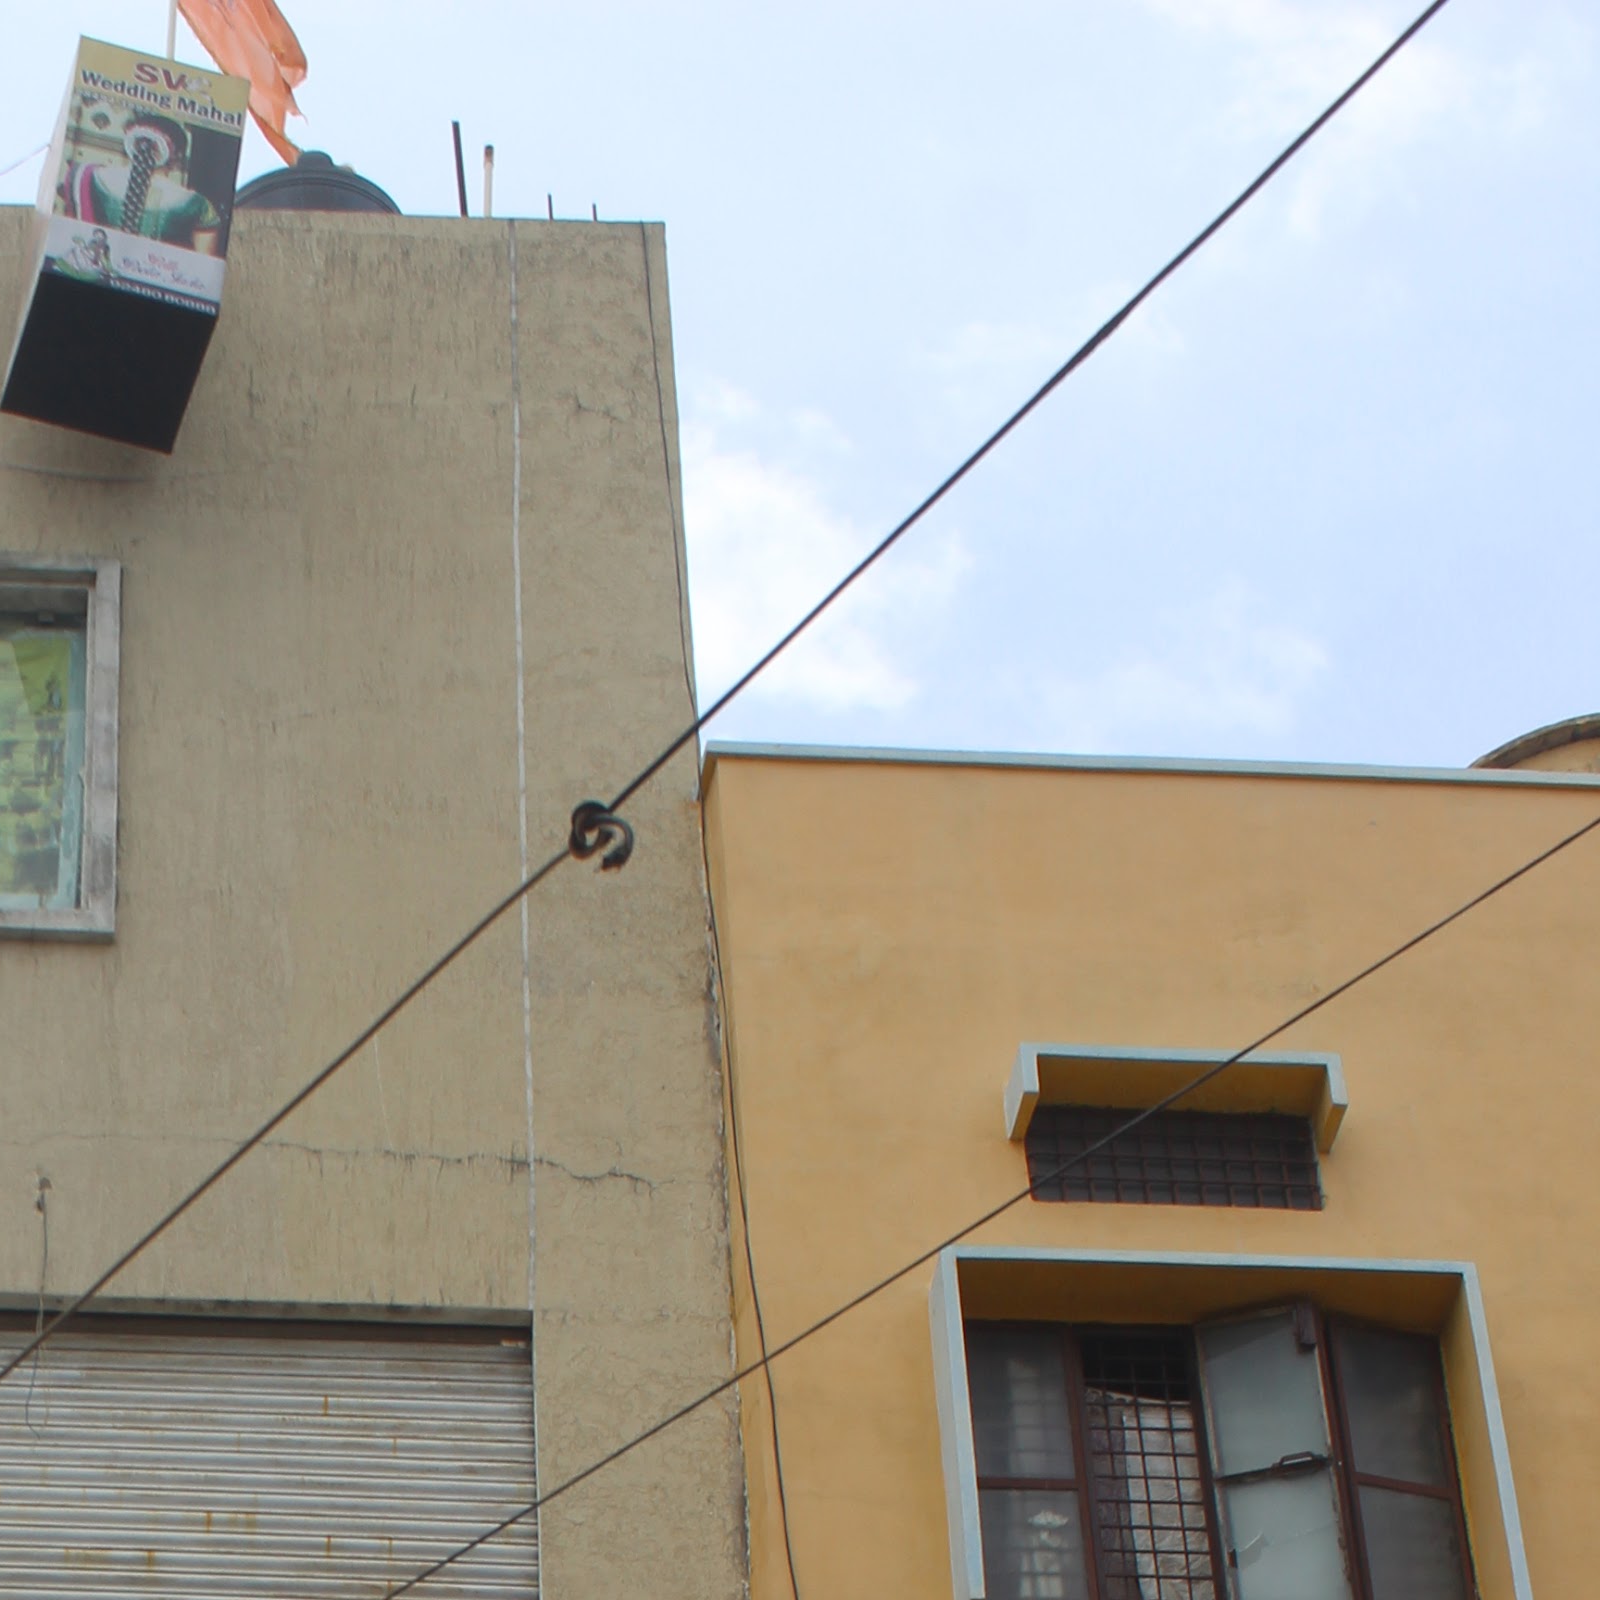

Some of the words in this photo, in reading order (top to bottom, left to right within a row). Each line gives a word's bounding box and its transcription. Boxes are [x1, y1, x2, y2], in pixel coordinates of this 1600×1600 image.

[81, 69, 172, 110] Wedding
[177, 96, 242, 126] Mahal
[134, 62, 188, 91] SV
